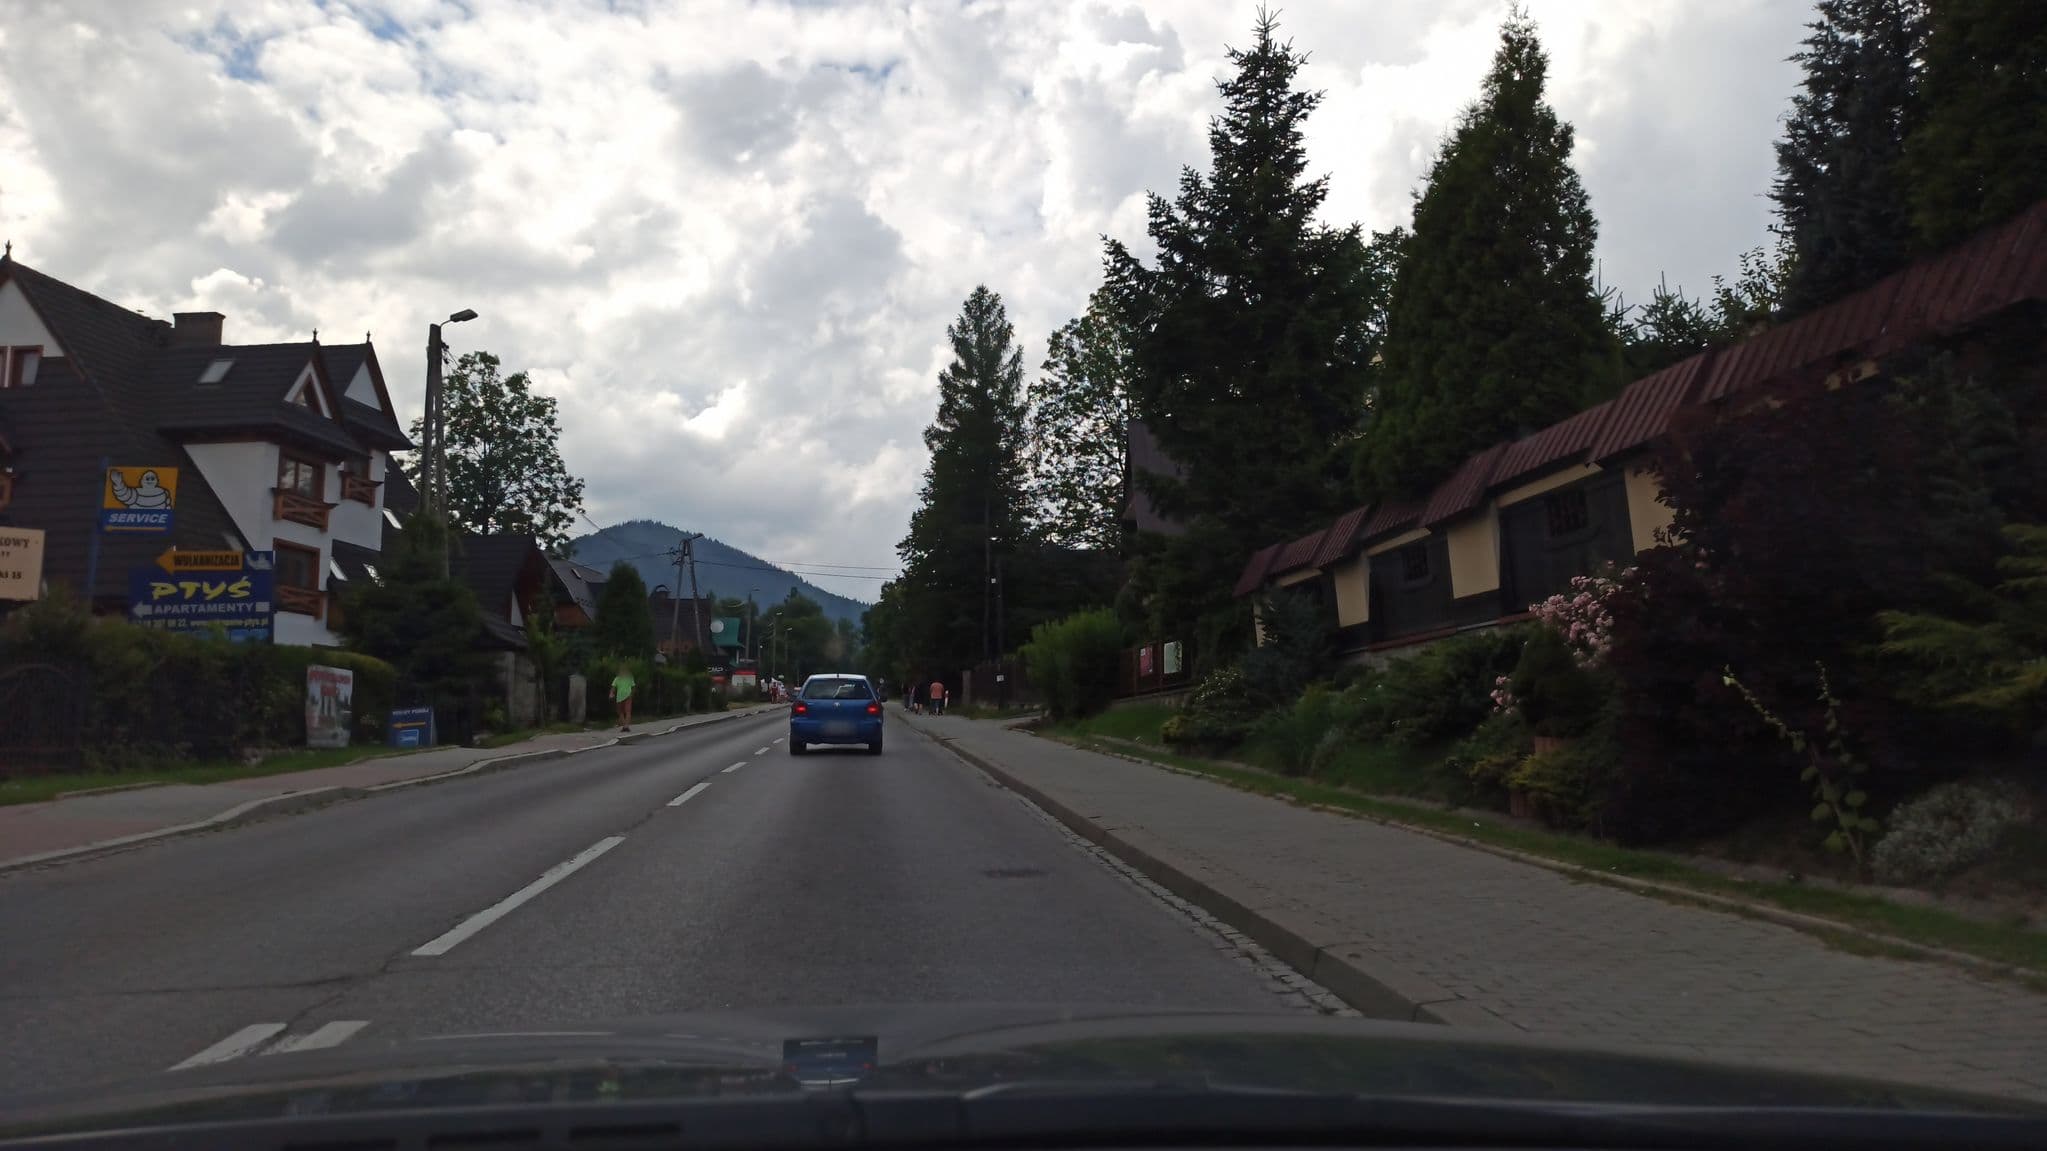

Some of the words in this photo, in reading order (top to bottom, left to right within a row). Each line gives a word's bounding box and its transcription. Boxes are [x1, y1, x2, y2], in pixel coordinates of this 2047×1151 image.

[109, 513, 169, 524] SERVICE
[174, 555, 240, 567] WULKANIZACJA
[149, 575, 252, 600] PTYŚ
[154, 602, 254, 615] APARTAMENTY
